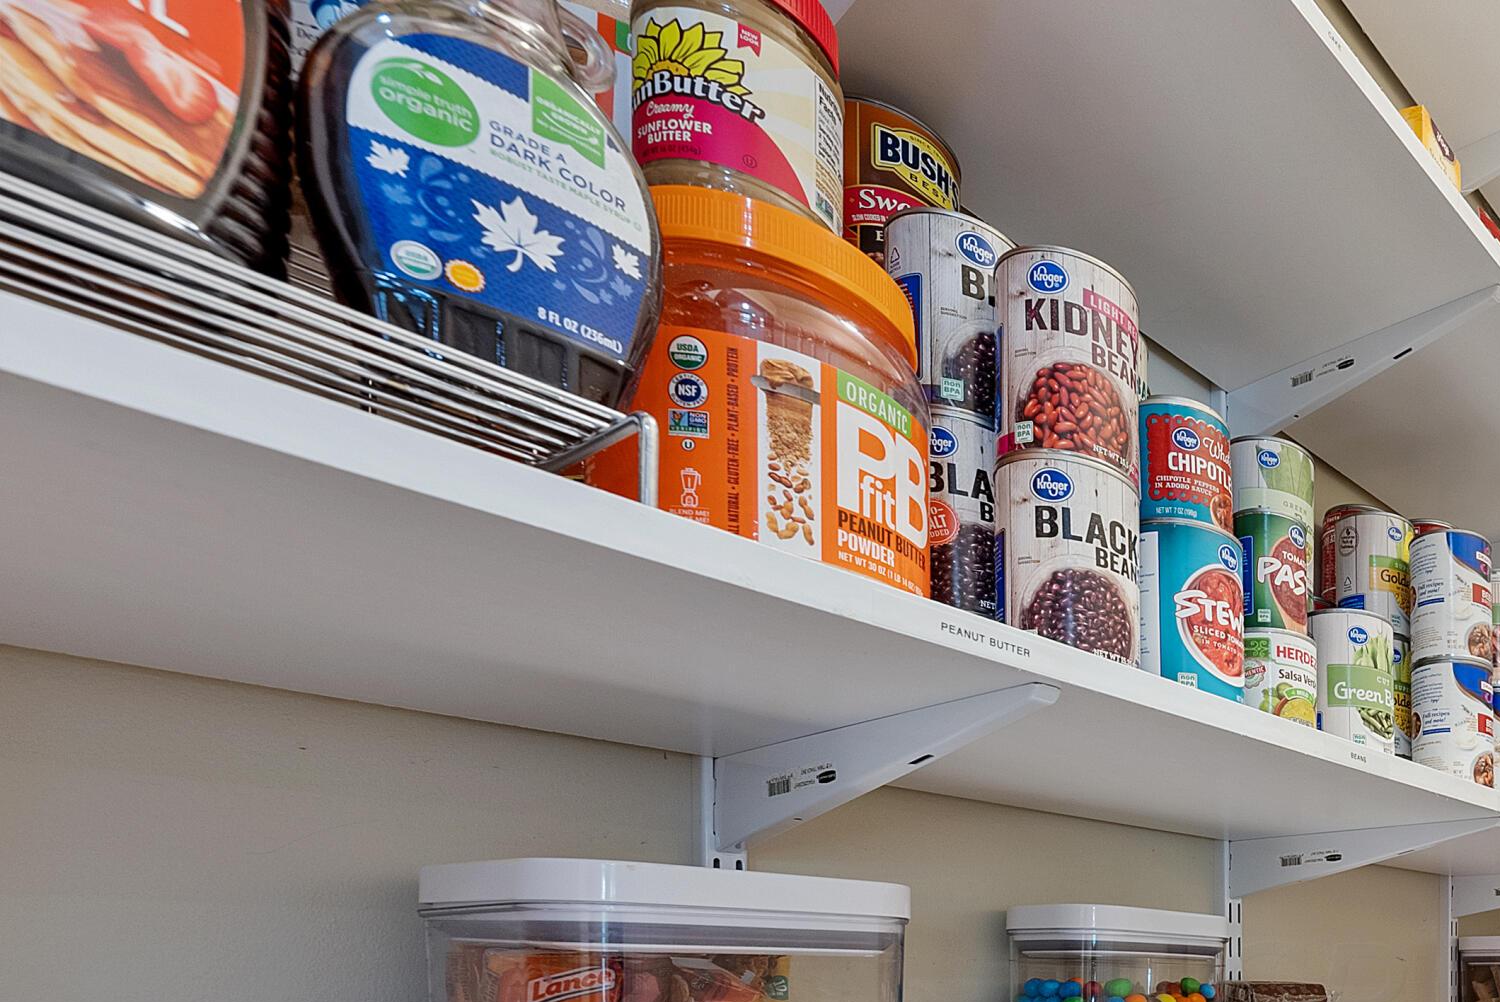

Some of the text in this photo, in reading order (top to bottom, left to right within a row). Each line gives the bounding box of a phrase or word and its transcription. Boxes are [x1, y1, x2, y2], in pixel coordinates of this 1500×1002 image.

[378, 87, 473, 133] organic
[646, 101, 695, 119] Creamy
[489, 120, 567, 165] GRADE A
[638, 119, 713, 139] SUNFLOWER
[647, 131, 692, 144] BUTTER
[490, 134, 627, 212] DARK COLOR
[879, 127, 960, 213] BUSH'S
[909, 172, 948, 206] BEST
[1033, 265, 1064, 289] Kroger
[537, 306, 579, 333] 8 FL OZ
[1089, 295, 1126, 326] LIGHT
[677, 342, 699, 352] USDA
[678, 383, 698, 397] NSF
[689, 412, 707, 420] NON
[669, 425, 708, 435] VERIFIED
[727, 347, 739, 525] NATURAL GLUTEN-FREE PLANT-BASED PROTEIN
[837, 401, 928, 551] PB
[1035, 475, 1069, 497] Kroger
[1155, 475, 1192, 485] CHIPOTLE
[858, 474, 896, 530] fit
[838, 509, 926, 573] PEANUT BUTTER
[1034, 504, 1138, 563] BLACK
[837, 529, 895, 568] POWDER
[838, 550, 887, 577] NET WT 30 OZ
[940, 622, 1031, 658] PEANUT BUTTER
[1193, 624, 1226, 639] SLICED
[1278, 668, 1302, 684] Salsa
[1334, 680, 1385, 706] Green
[531, 967, 614, 1001] Lance
